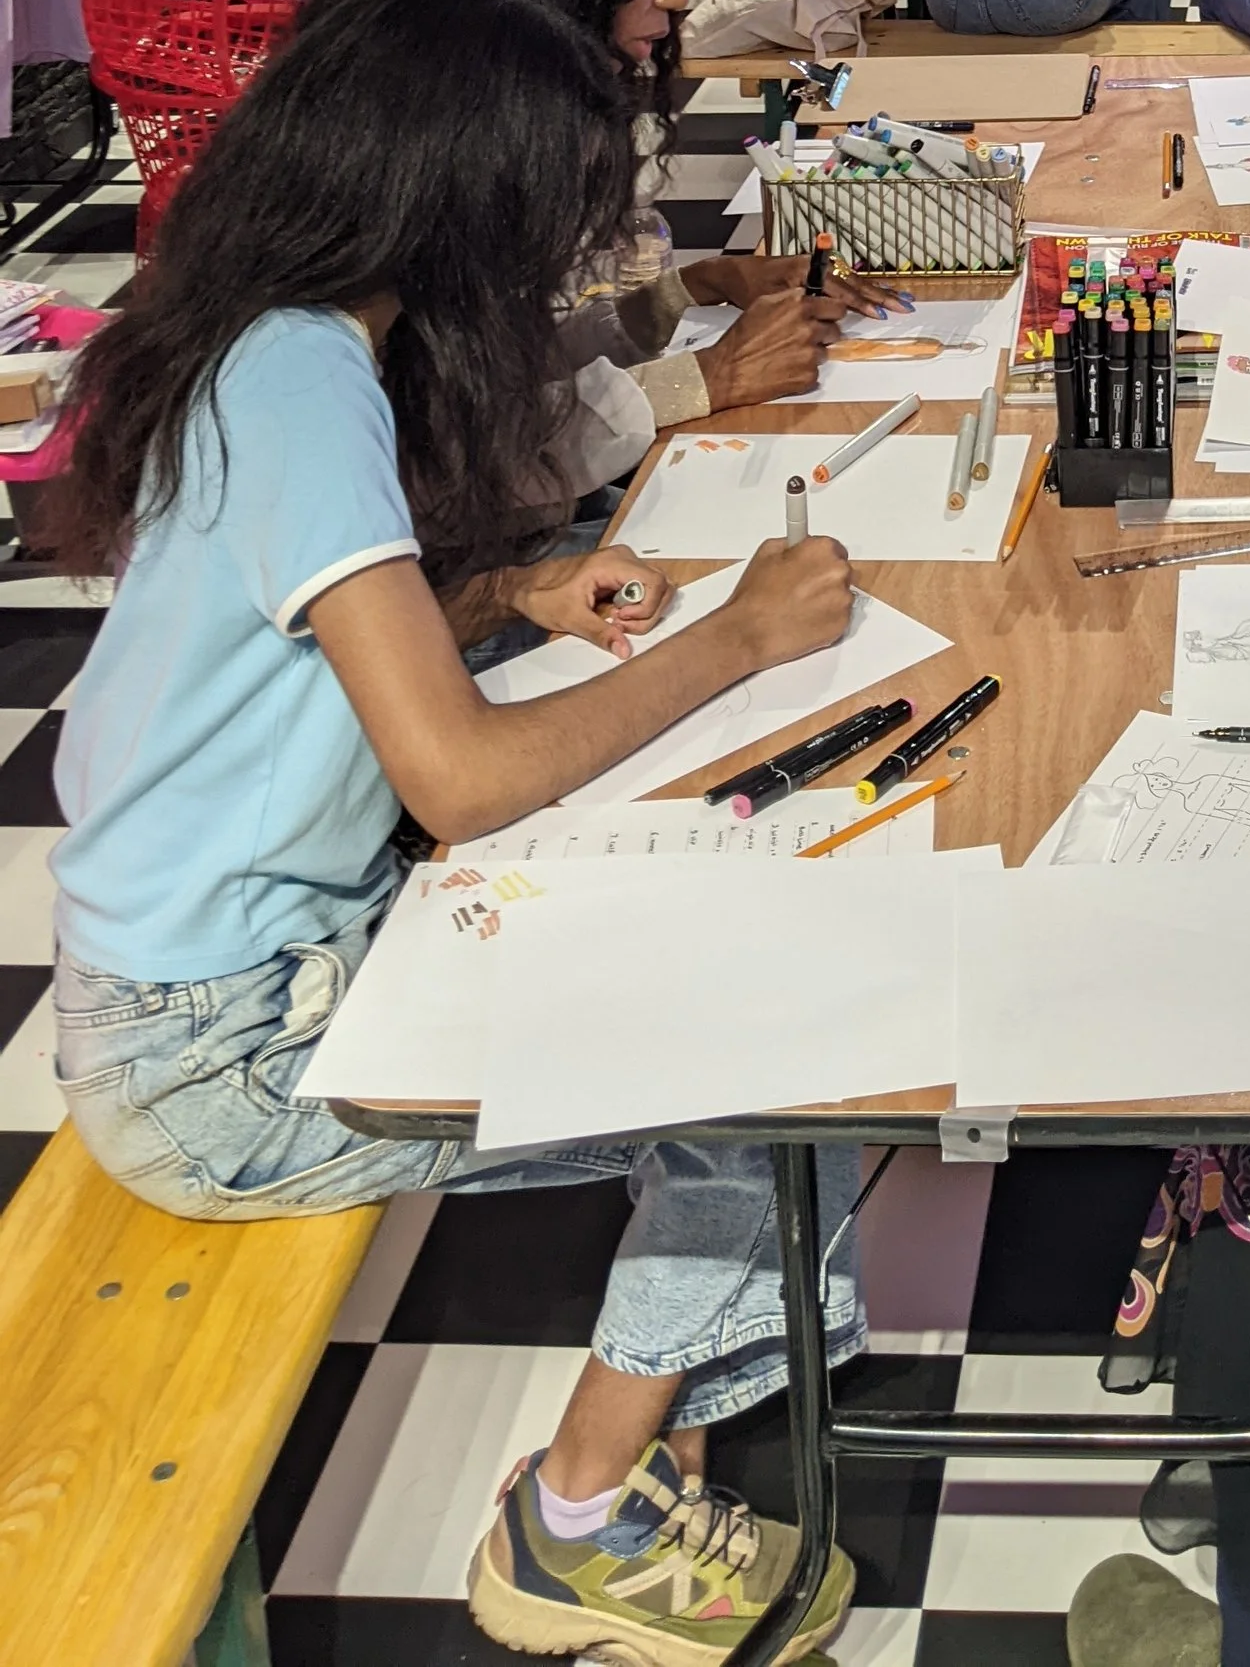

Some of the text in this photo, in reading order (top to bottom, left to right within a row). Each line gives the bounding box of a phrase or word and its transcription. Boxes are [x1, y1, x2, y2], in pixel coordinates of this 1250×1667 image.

[1128, 235, 1152, 244] TH
[1156, 232, 1184, 242] OF
[1187, 231, 1233, 241] TALK
